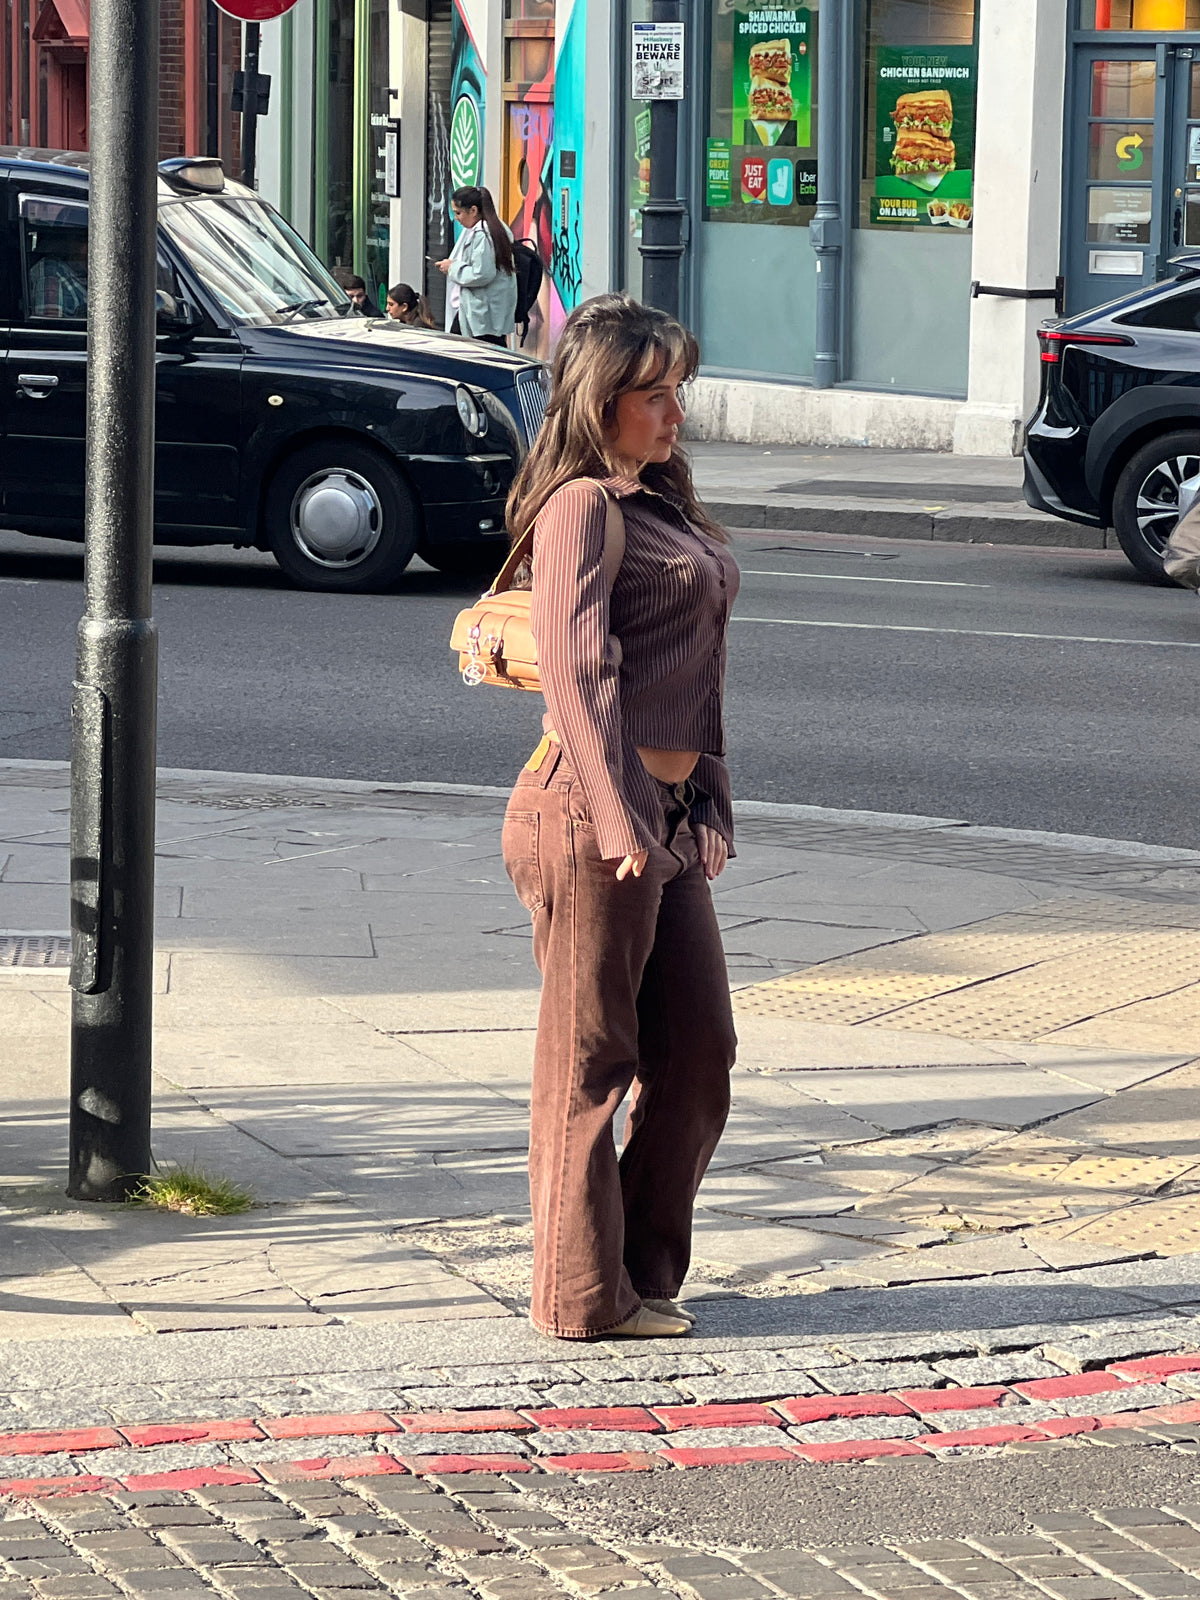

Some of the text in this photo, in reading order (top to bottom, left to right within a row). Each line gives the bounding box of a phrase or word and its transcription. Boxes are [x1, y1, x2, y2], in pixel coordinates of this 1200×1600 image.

[748, 11, 796, 22] SHAWARMA
[739, 22, 806, 34] SPICED CHICKEN
[902, 56, 948, 66] YOUR NEW
[880, 67, 969, 78] CHICKEN SANDWICH
[710, 160, 729, 169] GREAT
[709, 170, 729, 180] PEOPLE
[744, 164, 763, 177] JUST
[800, 172, 816, 182] Uber
[748, 177, 763, 188] EAT
[800, 184, 816, 194] Eats
[880, 199, 917, 208] YOUR SUB
[898, 208, 917, 217] SPUD
